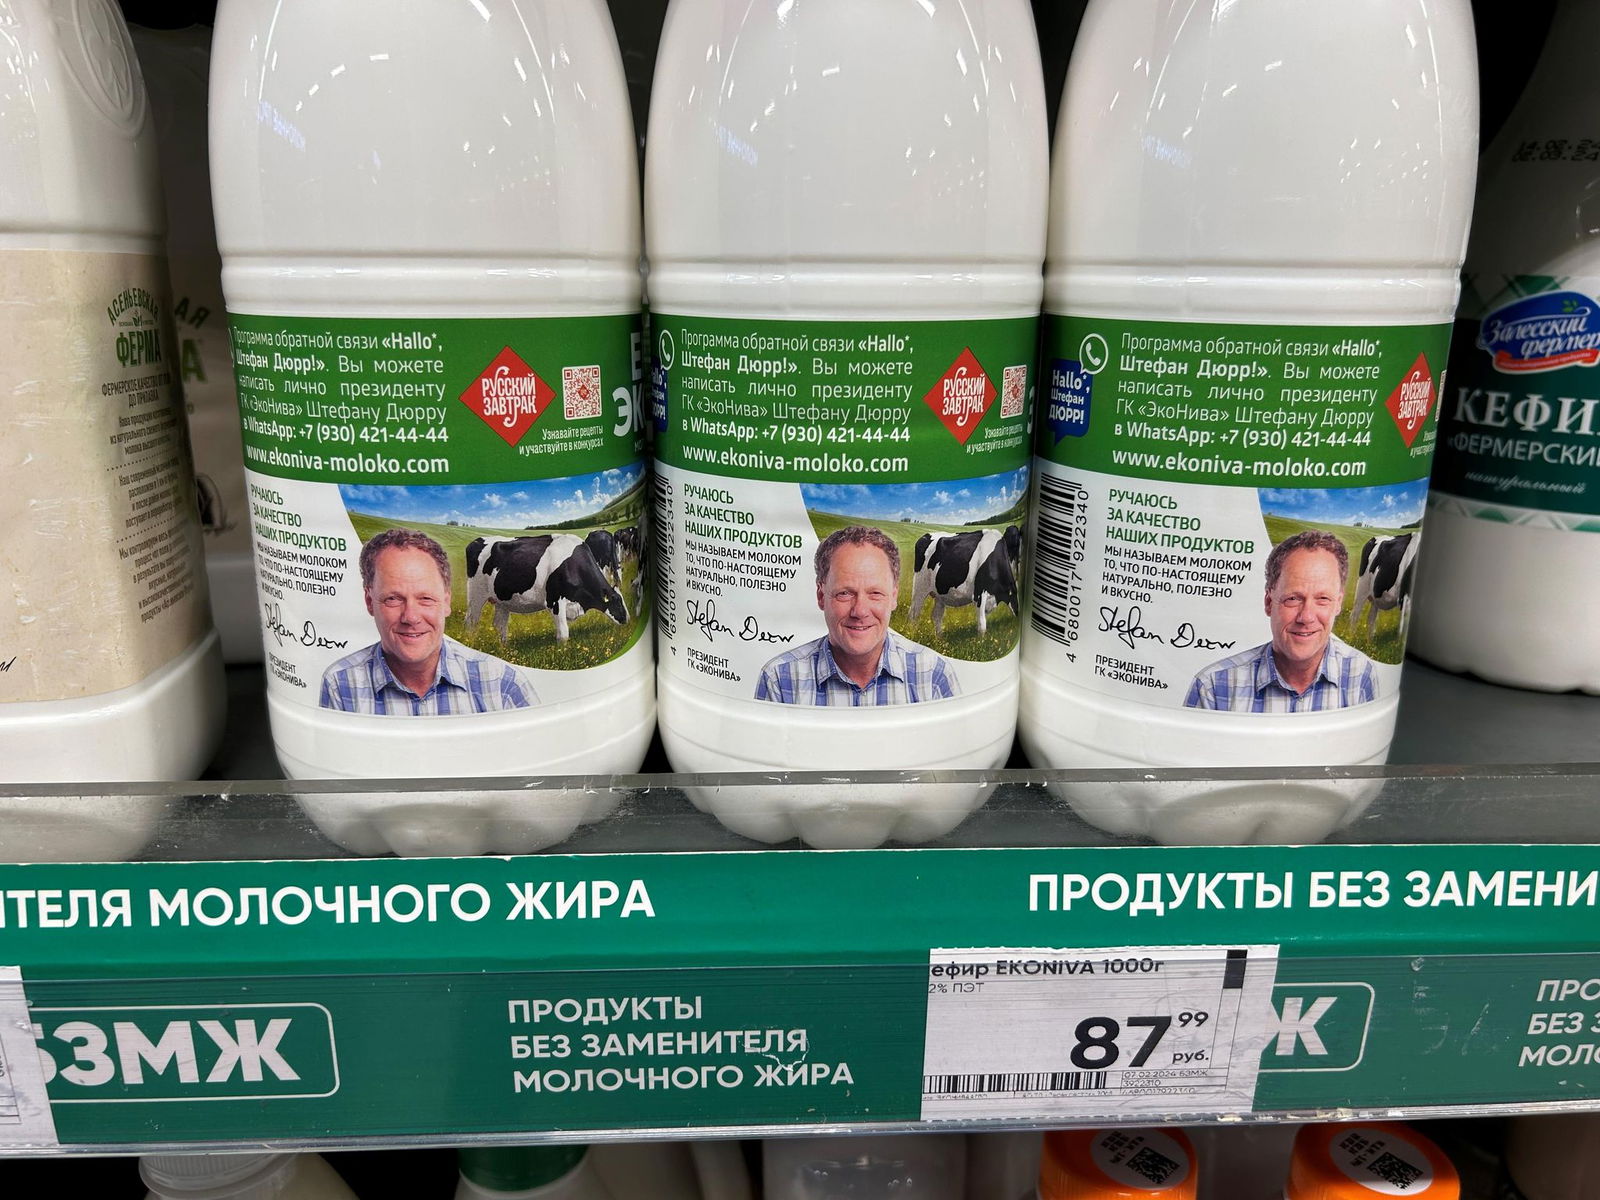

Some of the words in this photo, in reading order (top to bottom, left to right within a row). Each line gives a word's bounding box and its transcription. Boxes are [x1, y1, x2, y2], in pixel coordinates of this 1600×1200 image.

[116, 329, 162, 368] ФЕРМА
[274, 329, 333, 350] обратной
[336, 335, 378, 349] связи
[681, 328, 740, 350] Программа
[742, 332, 809, 357] обратной
[812, 339, 855, 353] связи
[1121, 332, 1202, 356] Программа
[1205, 336, 1282, 358] обратной
[1285, 342, 1329, 356] связи
[236, 348, 269, 371] Штефан
[273, 352, 329, 375] Дюрр!».
[339, 355, 364, 373] Вы
[374, 359, 444, 374] можете
[681, 350, 731, 375] Штефан
[737, 355, 802, 378] Дюрр!».
[812, 358, 837, 376] Вы
[848, 361, 913, 376] можете
[1119, 354, 1188, 378] Штефан
[1196, 359, 1272, 381] Дюрр!».
[1283, 362, 1309, 379] Вы
[1319, 366, 1380, 380] можете
[238, 375, 275, 392] написать
[284, 380, 327, 395] лично
[340, 382, 446, 401] президенту
[481, 366, 537, 398] РУССКИЙ
[681, 375, 736, 394] написать
[748, 382, 797, 397] лично
[812, 384, 913, 402] президенту
[943, 367, 986, 397] РУССКИЙ
[1118, 379, 1192, 398] написать
[1207, 385, 1265, 400] лично
[1280, 387, 1378, 406] президенту
[1400, 370, 1431, 400] РУССКИЙ
[942, 394, 984, 427] ЗАВТРАК
[1050, 388, 1085, 406] Штефан
[250, 399, 303, 417] «ЭкоНива»
[306, 401, 381, 424] Штефану
[386, 403, 447, 424] Дюрру
[483, 395, 538, 428] ЗАВТРАК
[682, 394, 695, 411] ГК
[696, 396, 768, 418] «ЭкоНива»
[773, 402, 850, 428] Штефану
[854, 404, 911, 426] Дюрру
[1048, 404, 1085, 424] ДЮРР!
[1115, 398, 1134, 415] ГК
[1137, 400, 1229, 422] «ЭкоНива»
[1235, 406, 1317, 428] Штефану
[1320, 408, 1375, 429] Дюрру
[1397, 398, 1429, 430] ЗАВТРАК
[1452, 387, 1600, 436] КЕФИ
[249, 416, 297, 442] WhatsApp:
[299, 423, 313, 438] +7
[316, 423, 356, 445] (930)
[359, 426, 449, 443] 421-44-44
[542, 426, 580, 442] Узнавайте
[690, 417, 759, 442] WhatsApp:
[762, 425, 778, 441] +7
[782, 424, 823, 446] (930)
[826, 427, 911, 443] 421-44-44
[1114, 423, 1122, 436] в
[1127, 421, 1215, 447] WhatsApp:
[1219, 429, 1238, 445] +7
[1242, 428, 1288, 450] (930)
[1291, 431, 1371, 447] 421-44-44
[246, 444, 450, 473] www.ekoniva-moloko.com
[525, 441, 568, 457] участвуйте
[682, 445, 909, 473] www.ekoniva-moloko.com
[1112, 449, 1366, 477] www.ekoniva-moloko.com
[250, 484, 284, 505] РУЧАЮСЬ
[684, 483, 734, 504] РУЧАЮСЬ
[1109, 488, 1178, 510] РУЧАЮСЬ
[259, 506, 302, 527] КАЧЕСТВО
[684, 502, 696, 515] ЗА
[696, 504, 755, 525] КАЧЕСТВО
[1073, 490, 1089, 562] 922340
[1107, 506, 1123, 521] ЗА
[1126, 510, 1201, 531] КАЧЕСТВО
[279, 530, 347, 552] ПРОДУКТОВ
[684, 520, 722, 540] НАШИХ
[723, 528, 803, 549] ПРОДУКТОВ
[1105, 525, 1158, 546] НАШИХ
[1161, 533, 1255, 554] ПРОДУКТОВ
[299, 553, 348, 569] МОЛОКОМ
[685, 539, 697, 550] МЫ
[698, 543, 746, 561] НАЗЫВАЕМ
[748, 551, 802, 566] МОЛОКОМ
[1104, 544, 1122, 557] МЫ
[1124, 548, 1187, 566] НАЗЫВАЕМ
[1189, 557, 1252, 571] МОЛОКОМ
[273, 561, 344, 583] ПО-НАСТОЯЩЕМУ
[685, 566, 738, 588] НАТУРАЛЬНО,
[740, 577, 787, 592] ПОЛЕЗНО
[696, 556, 711, 568] ЧТО
[712, 558, 797, 579] ПО-НАСТОЯЩЕМУ
[1103, 558, 1118, 571] ТО,
[1119, 561, 1139, 574] ЧТО
[1142, 564, 1245, 585] ПО-НАСТОЯЩЕМУ
[295, 581, 336, 596] ПОЛЕЗНО
[691, 580, 723, 597] ВКУСНО.
[1101, 585, 1108, 595] И
[1110, 587, 1153, 604] ВКУСНО.
[1102, 572, 1174, 594] НАТУРАЛЬНО,
[1176, 583, 1232, 598] ПОЛЕЗНО
[1067, 571, 1083, 641] 680017
[687, 647, 729, 669] ПРЕЗИДЕНТ
[1066, 652, 1077, 663] 4
[1095, 654, 1155, 676] ПРЕЗИДЕНТ
[695, 662, 741, 682] «ЭКОНИВА»
[1094, 665, 1106, 677] ГК
[1107, 669, 1168, 690] «ЭКОНИВА»
[0, 889, 132, 928] ТЕЛЯ
[150, 883, 491, 928] МОЛОЧНОГО
[505, 879, 656, 921] ЖИРА
[1029, 871, 1293, 917] ПРОДУКТЫ
[1309, 870, 1390, 909] БЕЗ
[1403, 867, 1598, 908] ЗАМЕНИ
[995, 960, 1095, 976] EKONIVA
[1103, 959, 1165, 974] 1000г
[953, 982, 985, 994] ПЭТ
[508, 995, 702, 1026] ПРОДУКТЫ
[1527, 1012, 1584, 1035] БЕЗ
[510, 1033, 572, 1059] БЕЗ
[581, 1029, 808, 1058] ЗАМЕНИТЕЛЯ
[1070, 1016, 1172, 1070] 87
[1178, 1012, 1209, 1028] 99
[1172, 1049, 1210, 1065] руб.
[513, 1064, 744, 1093] МОЛОЧНОГО
[753, 1062, 855, 1088] ЖИРА
[1179, 1068, 1209, 1077] БЗМЖ
